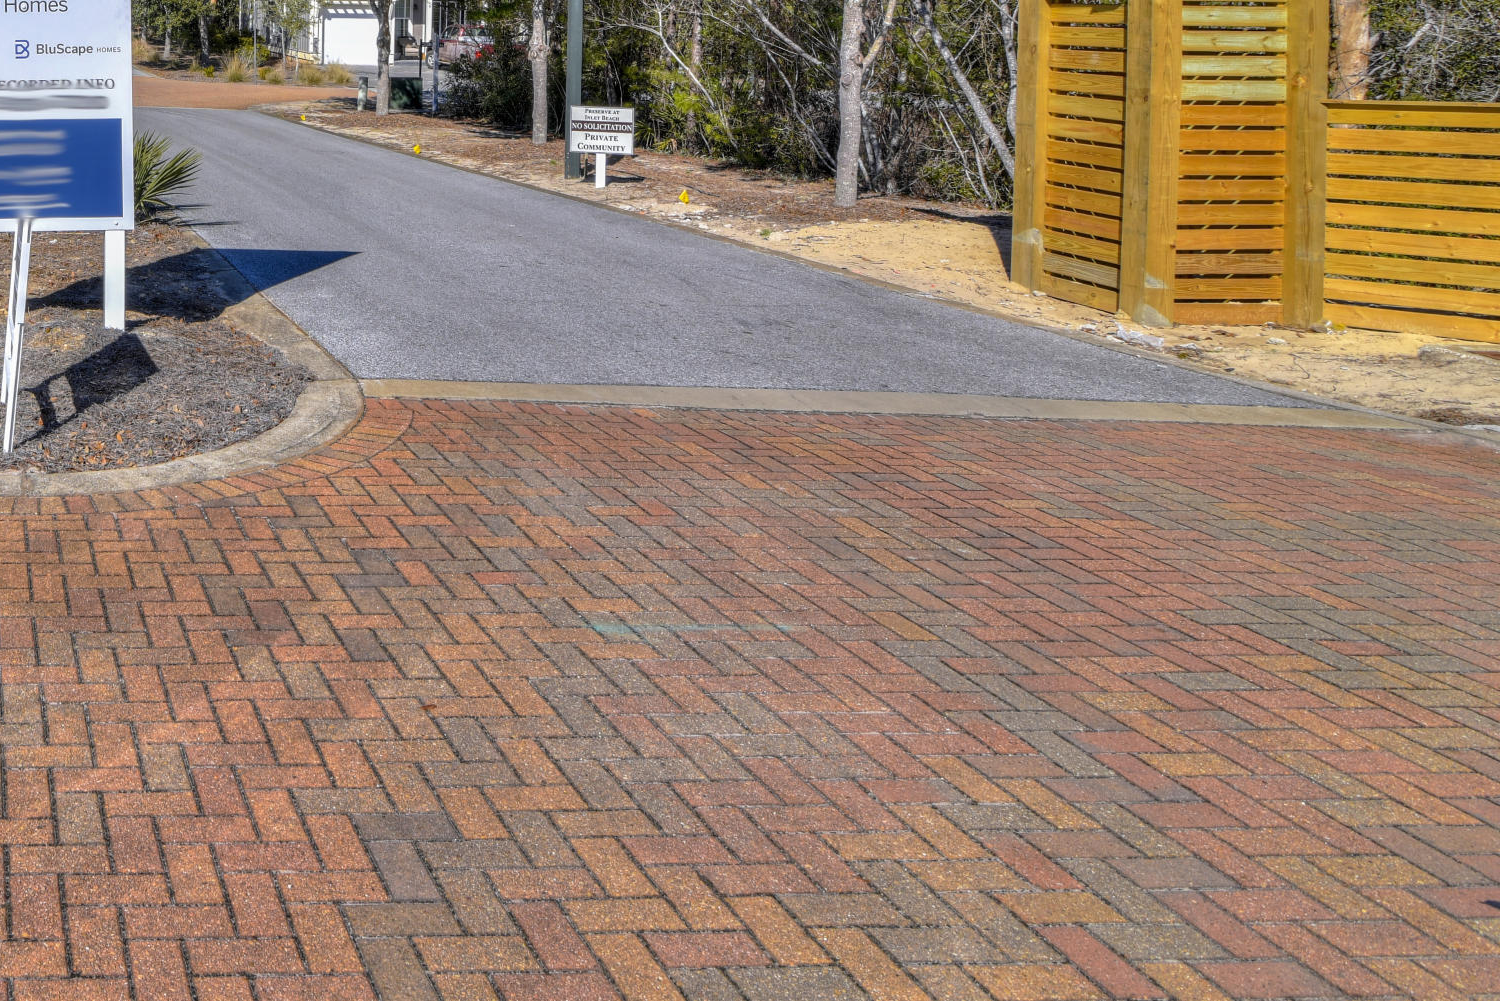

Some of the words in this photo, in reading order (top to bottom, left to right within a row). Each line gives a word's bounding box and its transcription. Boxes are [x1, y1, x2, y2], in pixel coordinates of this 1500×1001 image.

[36, 43, 94, 56] BluScape
[76, 78, 115, 90] INFO
[584, 123, 632, 132] SOLICITATION
[584, 133, 619, 142] PRIVATE
[578, 142, 626, 152] COMMUNITY
